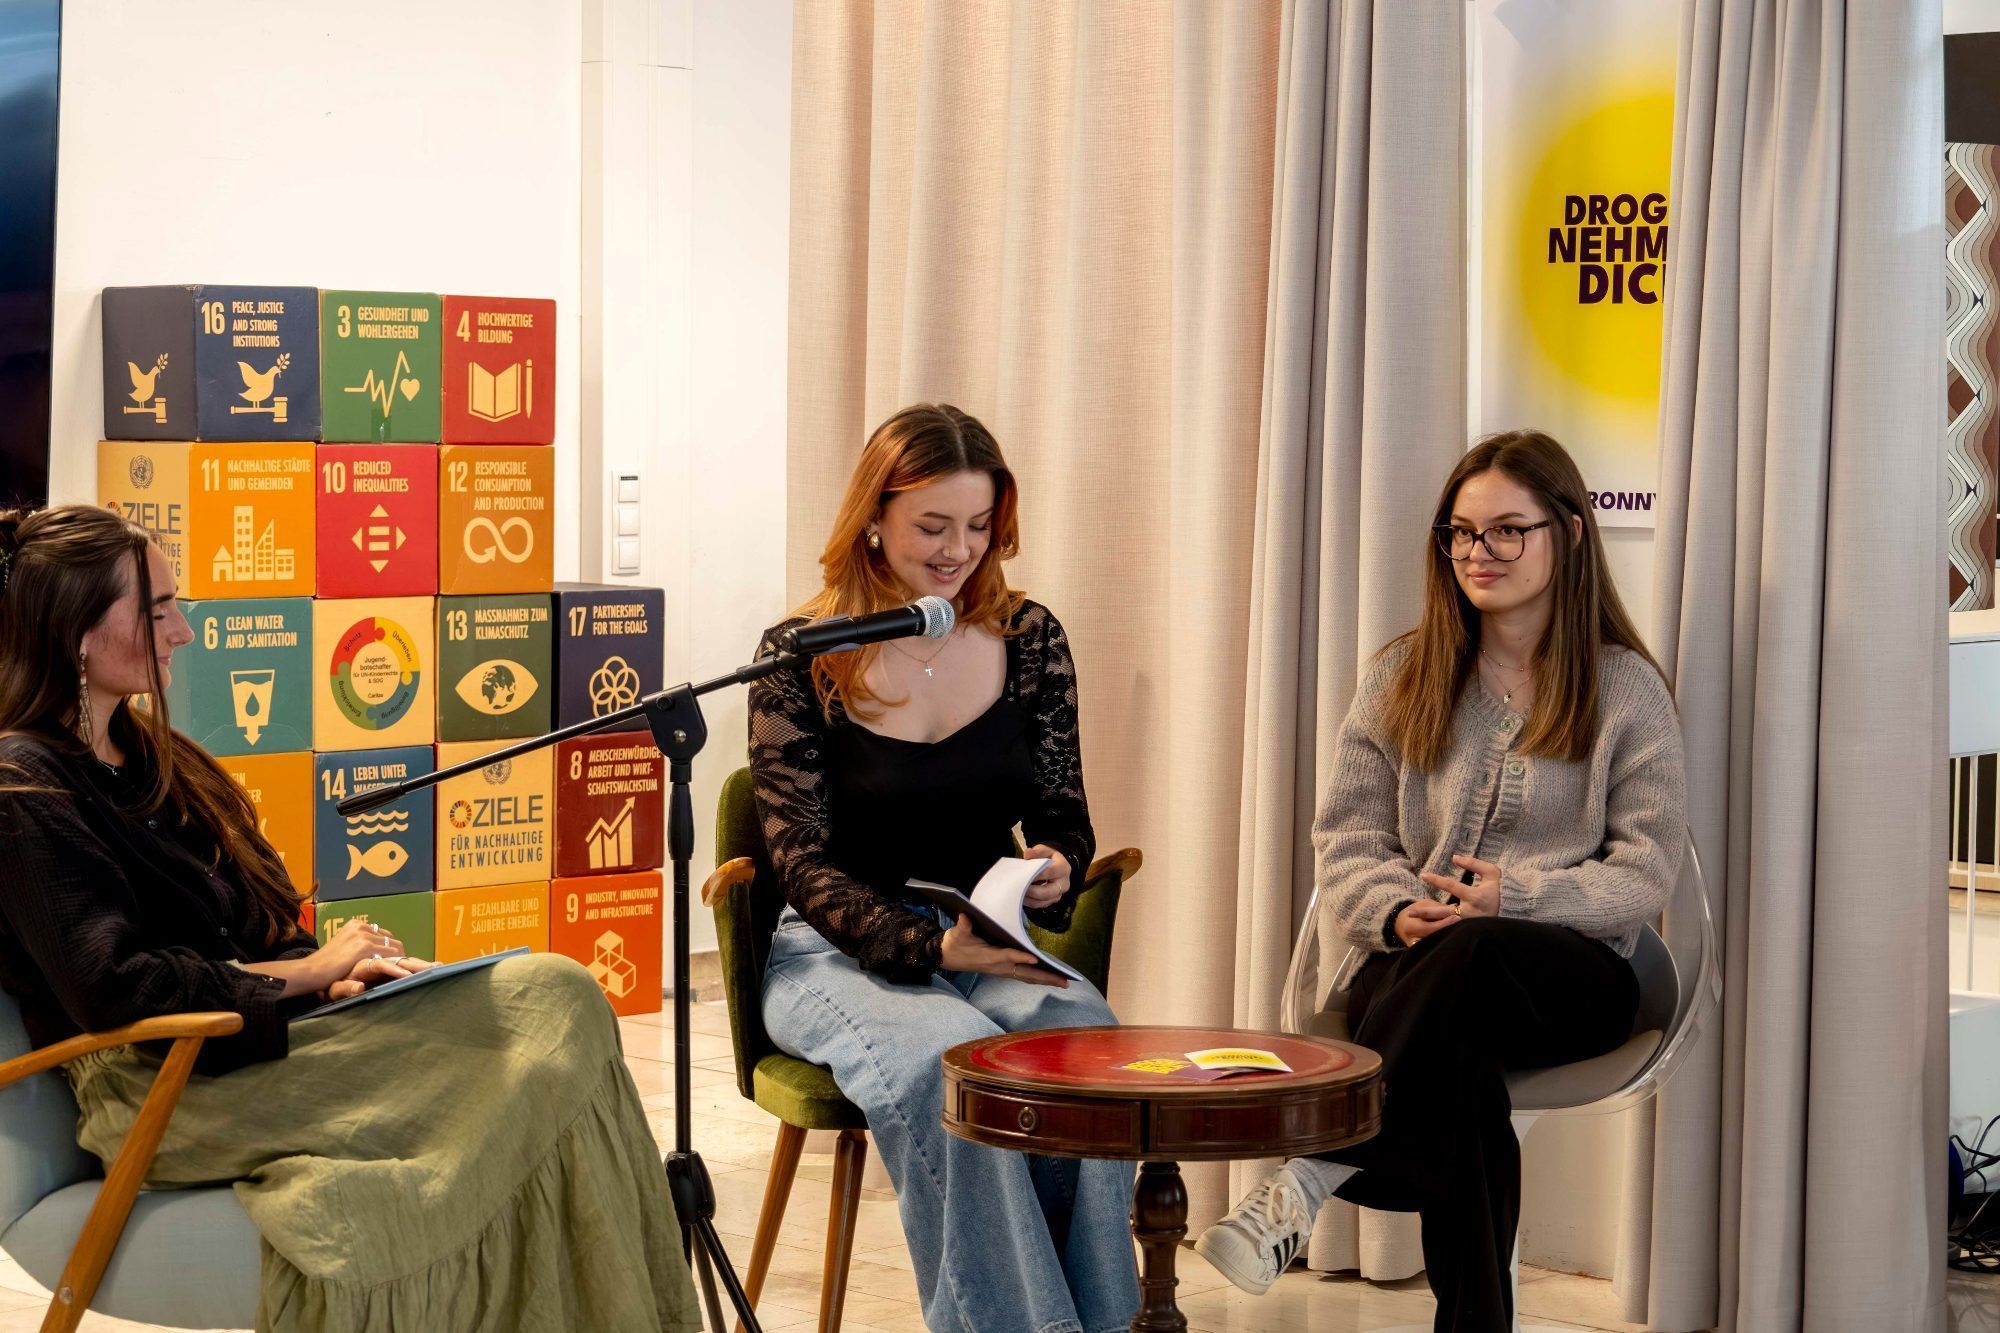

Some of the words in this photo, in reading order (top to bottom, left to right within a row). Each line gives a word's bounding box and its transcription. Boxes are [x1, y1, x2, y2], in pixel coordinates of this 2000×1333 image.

[1578, 263, 1667, 304] DIC
[232, 301, 256, 316] PEACE,
[256, 301, 284, 314] JUSTICE
[358, 306, 409, 322] GESUNDHEIT
[410, 308, 429, 322] UND
[201, 301, 225, 334] 16
[232, 320, 248, 332] AND
[249, 320, 278, 332] STRONG
[337, 305, 351, 338] 3
[456, 310, 471, 342] 4
[478, 312, 534, 328] HOCHWERTIGE
[358, 324, 419, 339] WOHLERGEHEN
[478, 329, 513, 344] BILDUNG
[232, 335, 280, 348] INSTITUTIONS
[228, 458, 282, 473] NACHHALTIGE
[283, 456, 312, 473] STÄDTE
[353, 461, 392, 476] REDUCED
[475, 461, 527, 476] RESPONSIBLE
[201, 458, 220, 492] 11
[322, 461, 346, 494] 10
[448, 461, 468, 493] 12
[228, 478, 246, 491] UND
[248, 477, 294, 490] GEMEINDEN
[353, 478, 409, 493] INEQUALITIES
[474, 478, 532, 492] CONSUMPTION
[474, 496, 492, 510] AND
[494, 496, 544, 510] PRODUCTION
[1588, 491, 1656, 510] RONN
[474, 608, 529, 624] MASSNAHMEN
[530, 607, 548, 622] ZUM
[592, 604, 646, 619] PARTNERSHIPS
[226, 616, 254, 631] CLEAN
[255, 614, 284, 630] WATER
[446, 610, 468, 641] 13
[568, 606, 587, 637] 17
[592, 622, 608, 636] FOR
[609, 622, 624, 634] THE
[624, 620, 648, 634] GOALS
[204, 616, 219, 650] 6
[225, 633, 246, 649] AND
[247, 632, 298, 648] SANITATION
[475, 625, 529, 640] KLIMASCHUTZ
[353, 766, 379, 781] LEBEN
[380, 764, 408, 779] UNTER
[570, 750, 583, 780] 8
[588, 764, 614, 779] ARBEIT
[614, 764, 631, 777] UND
[632, 762, 654, 776] WIRT-
[321, 768, 346, 801] 14
[587, 778, 658, 796] SCHAFTSWACHSTUM
[472, 794, 544, 828] ZIELE
[450, 833, 470, 851] FÜR
[475, 830, 544, 850] NACHHALTIGE
[450, 848, 544, 870] ENTWICKLUNG
[586, 890, 618, 904] INDUSTRY,
[620, 888, 658, 901] INNOVATION
[472, 901, 520, 918] BEZAHLBARE
[522, 898, 539, 912] UND
[566, 893, 579, 924] 9
[585, 909, 600, 920] AND
[453, 905, 465, 936] 7
[471, 918, 506, 934] SAUBERE
[507, 914, 539, 930] ENERGIE
